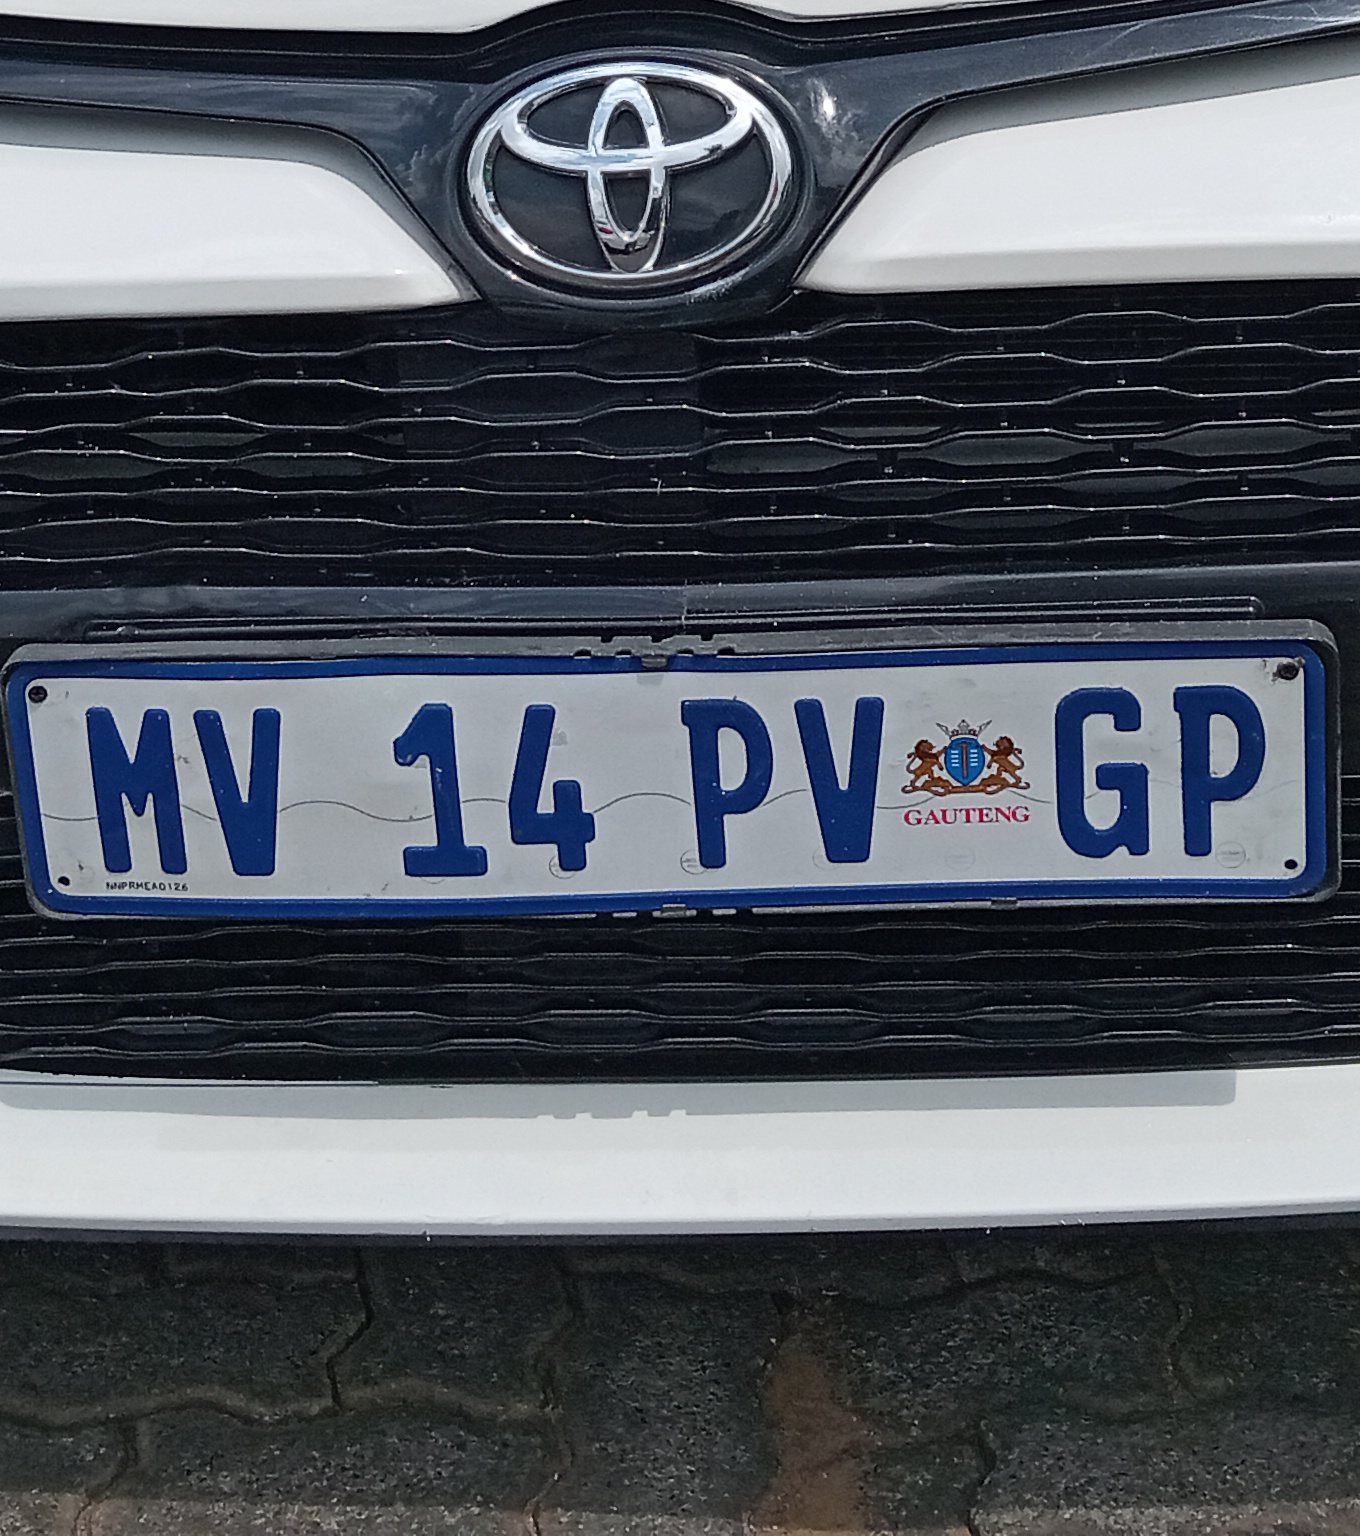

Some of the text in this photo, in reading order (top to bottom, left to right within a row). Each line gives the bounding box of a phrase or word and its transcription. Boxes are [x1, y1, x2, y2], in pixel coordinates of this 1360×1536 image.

[85, 685, 1266, 878] MV 14 PV GP
[903, 805, 1031, 826] GAUTENG
